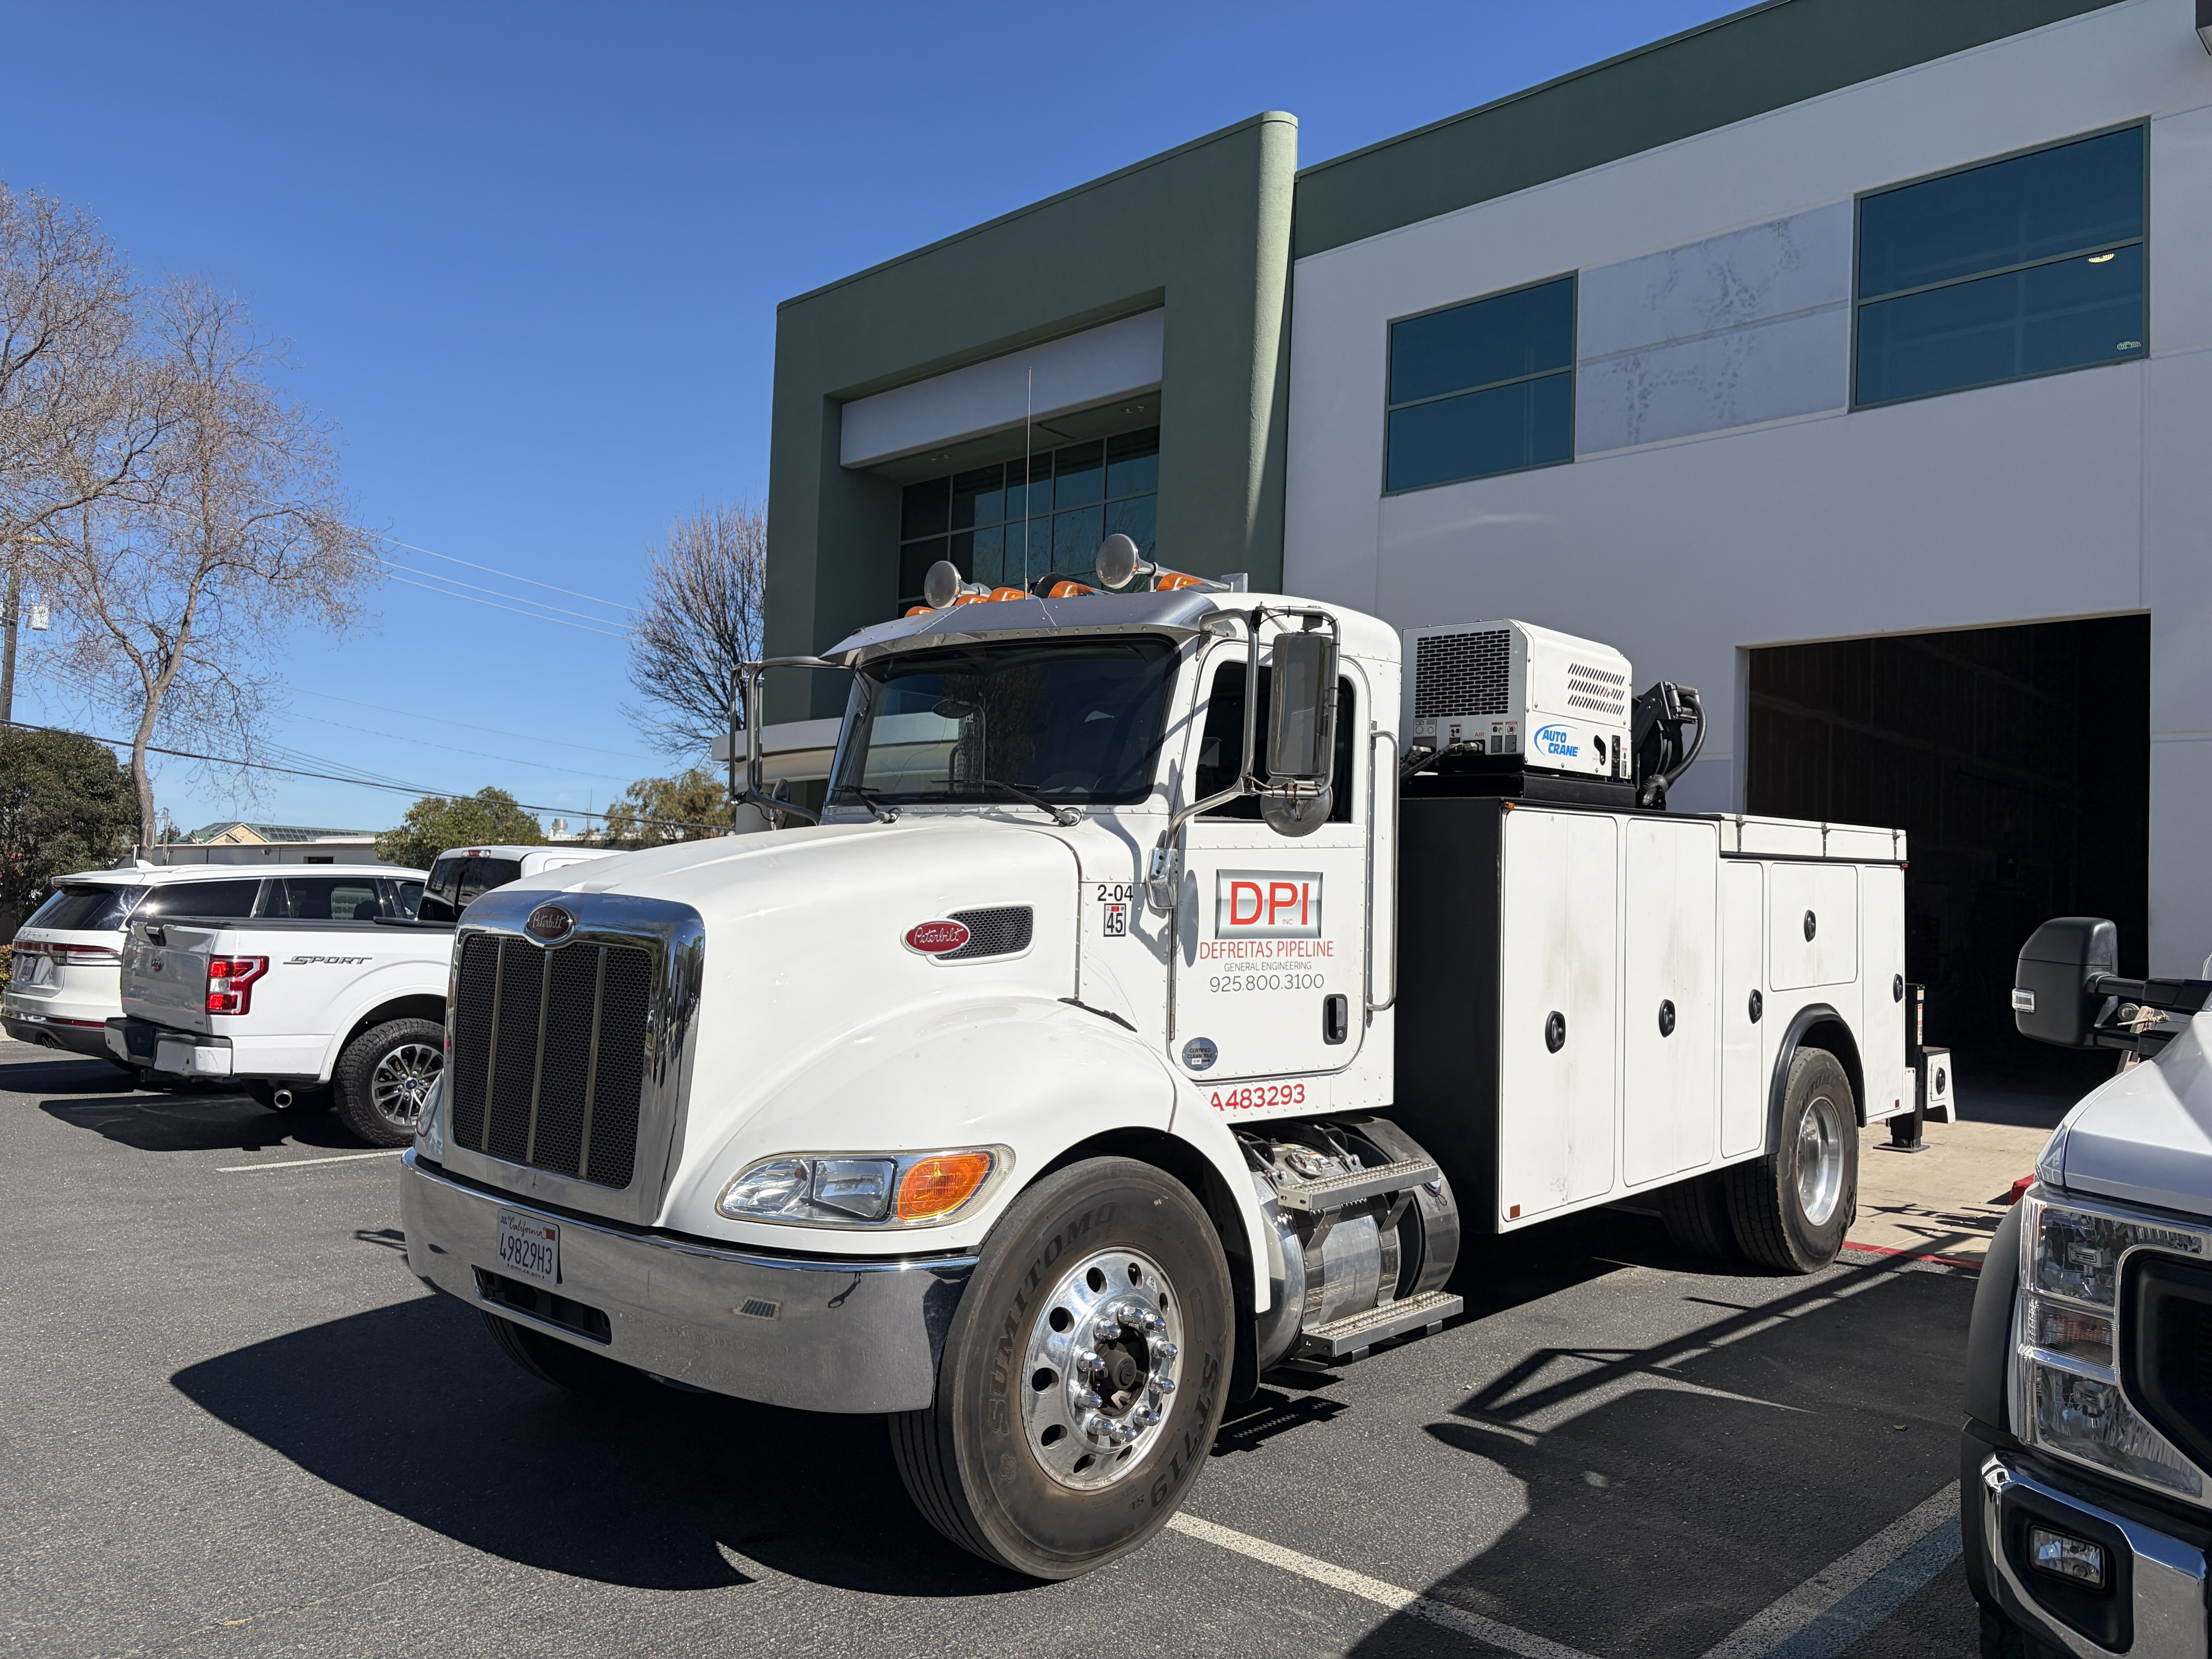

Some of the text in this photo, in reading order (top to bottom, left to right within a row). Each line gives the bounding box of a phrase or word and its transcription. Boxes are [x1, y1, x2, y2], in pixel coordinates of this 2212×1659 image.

[1542, 730, 1566, 743] AUTO
[1548, 742, 1578, 757] CRANE
[1097, 884, 1133, 902] 2-04
[1230, 881, 1309, 925] DPI
[533, 912, 566, 929] Peterbilt
[1106, 912, 1123, 933] 45
[914, 927, 963, 945] Peterbilt
[1200, 941, 1333, 959] DEFREITAS PIPELINE
[283, 955, 373, 965] SPORT
[1224, 961, 1312, 972] GENERAL ENGINEERING
[1210, 974, 1324, 993] 925.800.3100
[1210, 1084, 1305, 1111] A483293
[509, 1217, 543, 1238] California
[500, 1233, 552, 1275] 49829H3
[510, 1265, 541, 1279] dmv.ca.gov
[988, 1201, 1117, 1434] SUMITOMO
[1150, 1352, 1219, 1509] ST719
